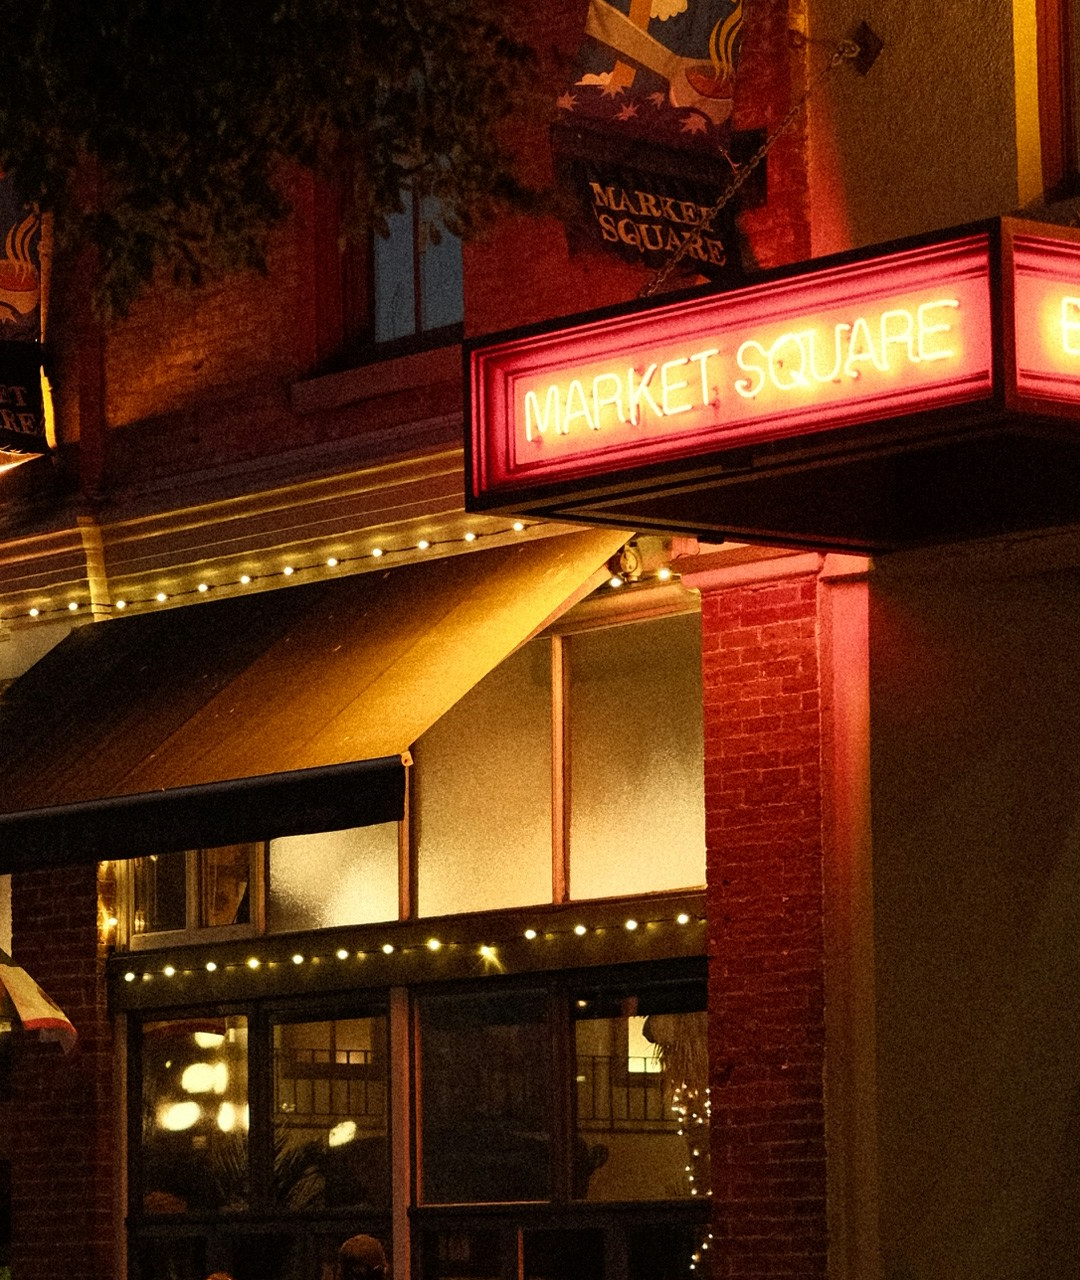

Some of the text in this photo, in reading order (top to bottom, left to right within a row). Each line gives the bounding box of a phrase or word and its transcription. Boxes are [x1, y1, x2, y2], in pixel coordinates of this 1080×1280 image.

[588, 181, 715, 233] MARKET
[598, 213, 727, 266] SQUARE
[523, 348, 720, 443] MARKET
[734, 298, 960, 399] SQUARE
